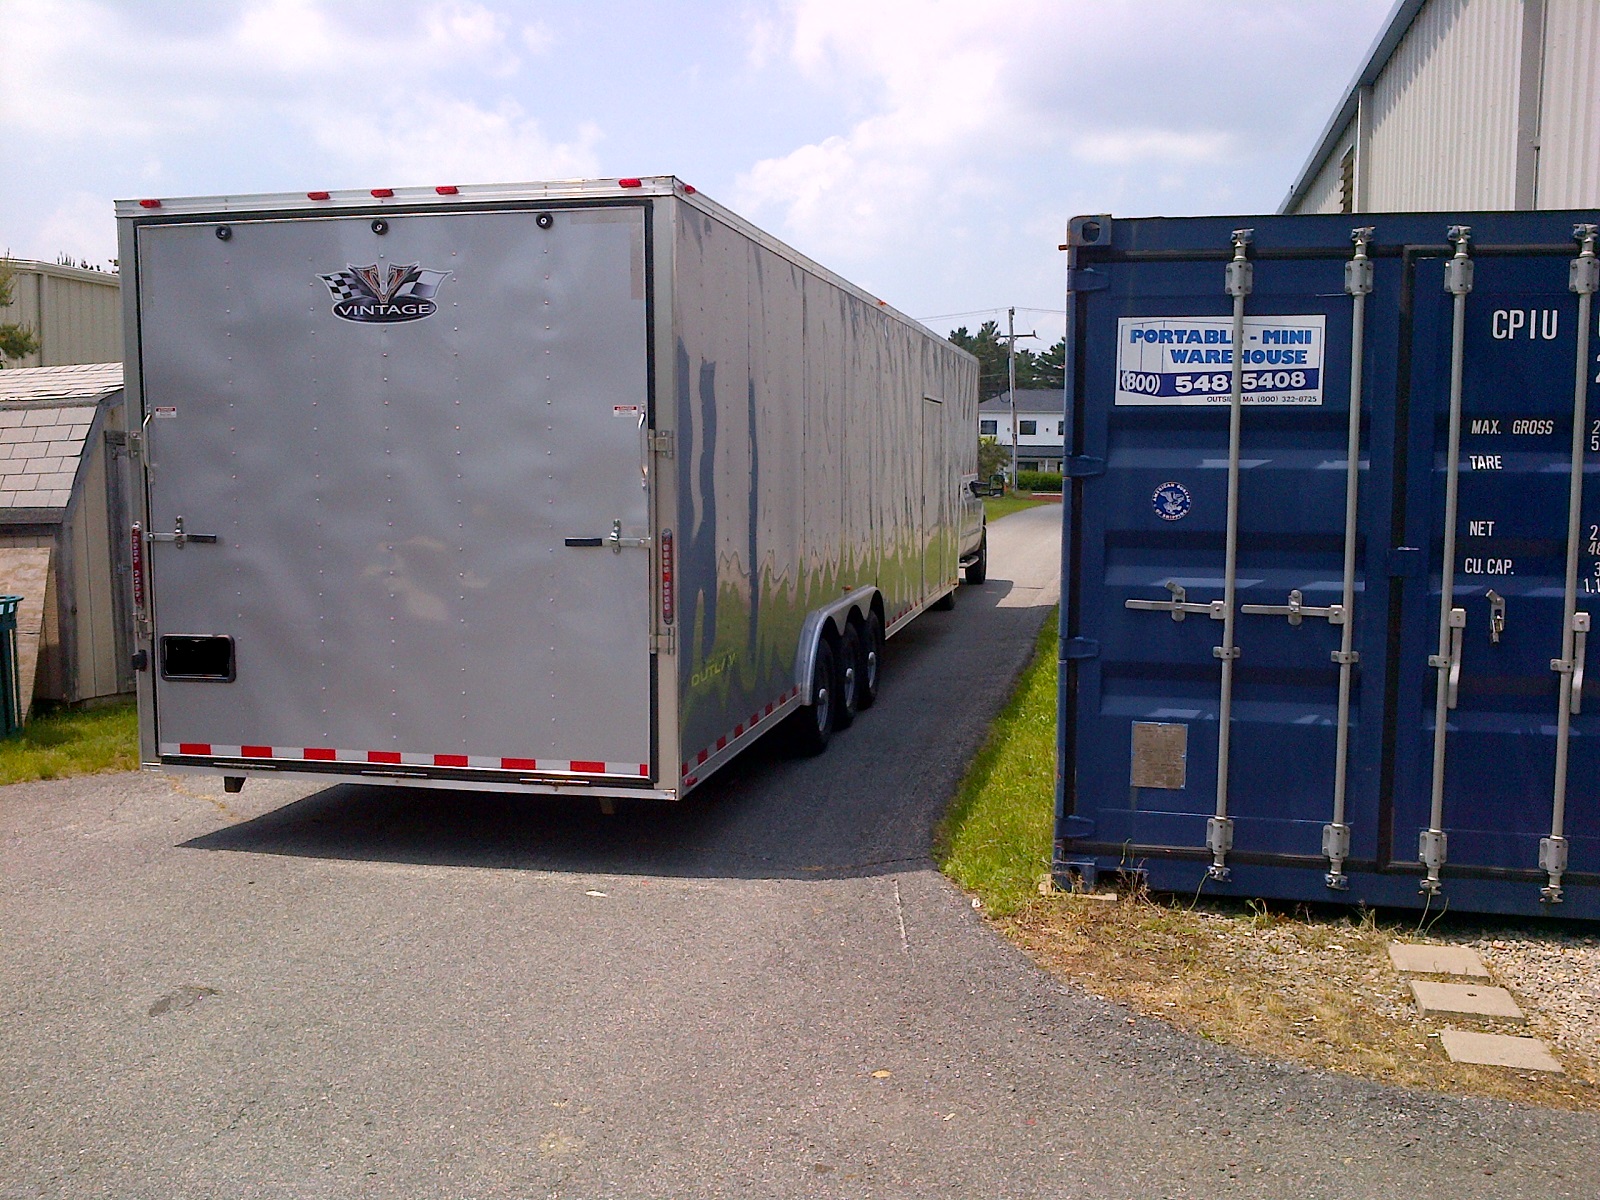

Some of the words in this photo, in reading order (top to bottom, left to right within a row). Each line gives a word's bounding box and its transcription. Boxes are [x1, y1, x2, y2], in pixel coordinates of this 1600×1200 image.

[338, 304, 430, 316] VINTAGE
[1492, 310, 1558, 339] CPIU
[1130, 330, 1243, 344] PORTABL
[1262, 330, 1312, 344] MINI
[1170, 350, 1308, 364] WAREHOUSE
[1121, 371, 1160, 395] (800)
[1175, 372, 1306, 393] 5485408
[1471, 420, 1501, 435] MAX.
[1512, 420, 1554, 435] GROSS
[1469, 455, 1502, 470] TARE
[1469, 521, 1495, 536] NET
[1487, 559, 1514, 575] CAP.
